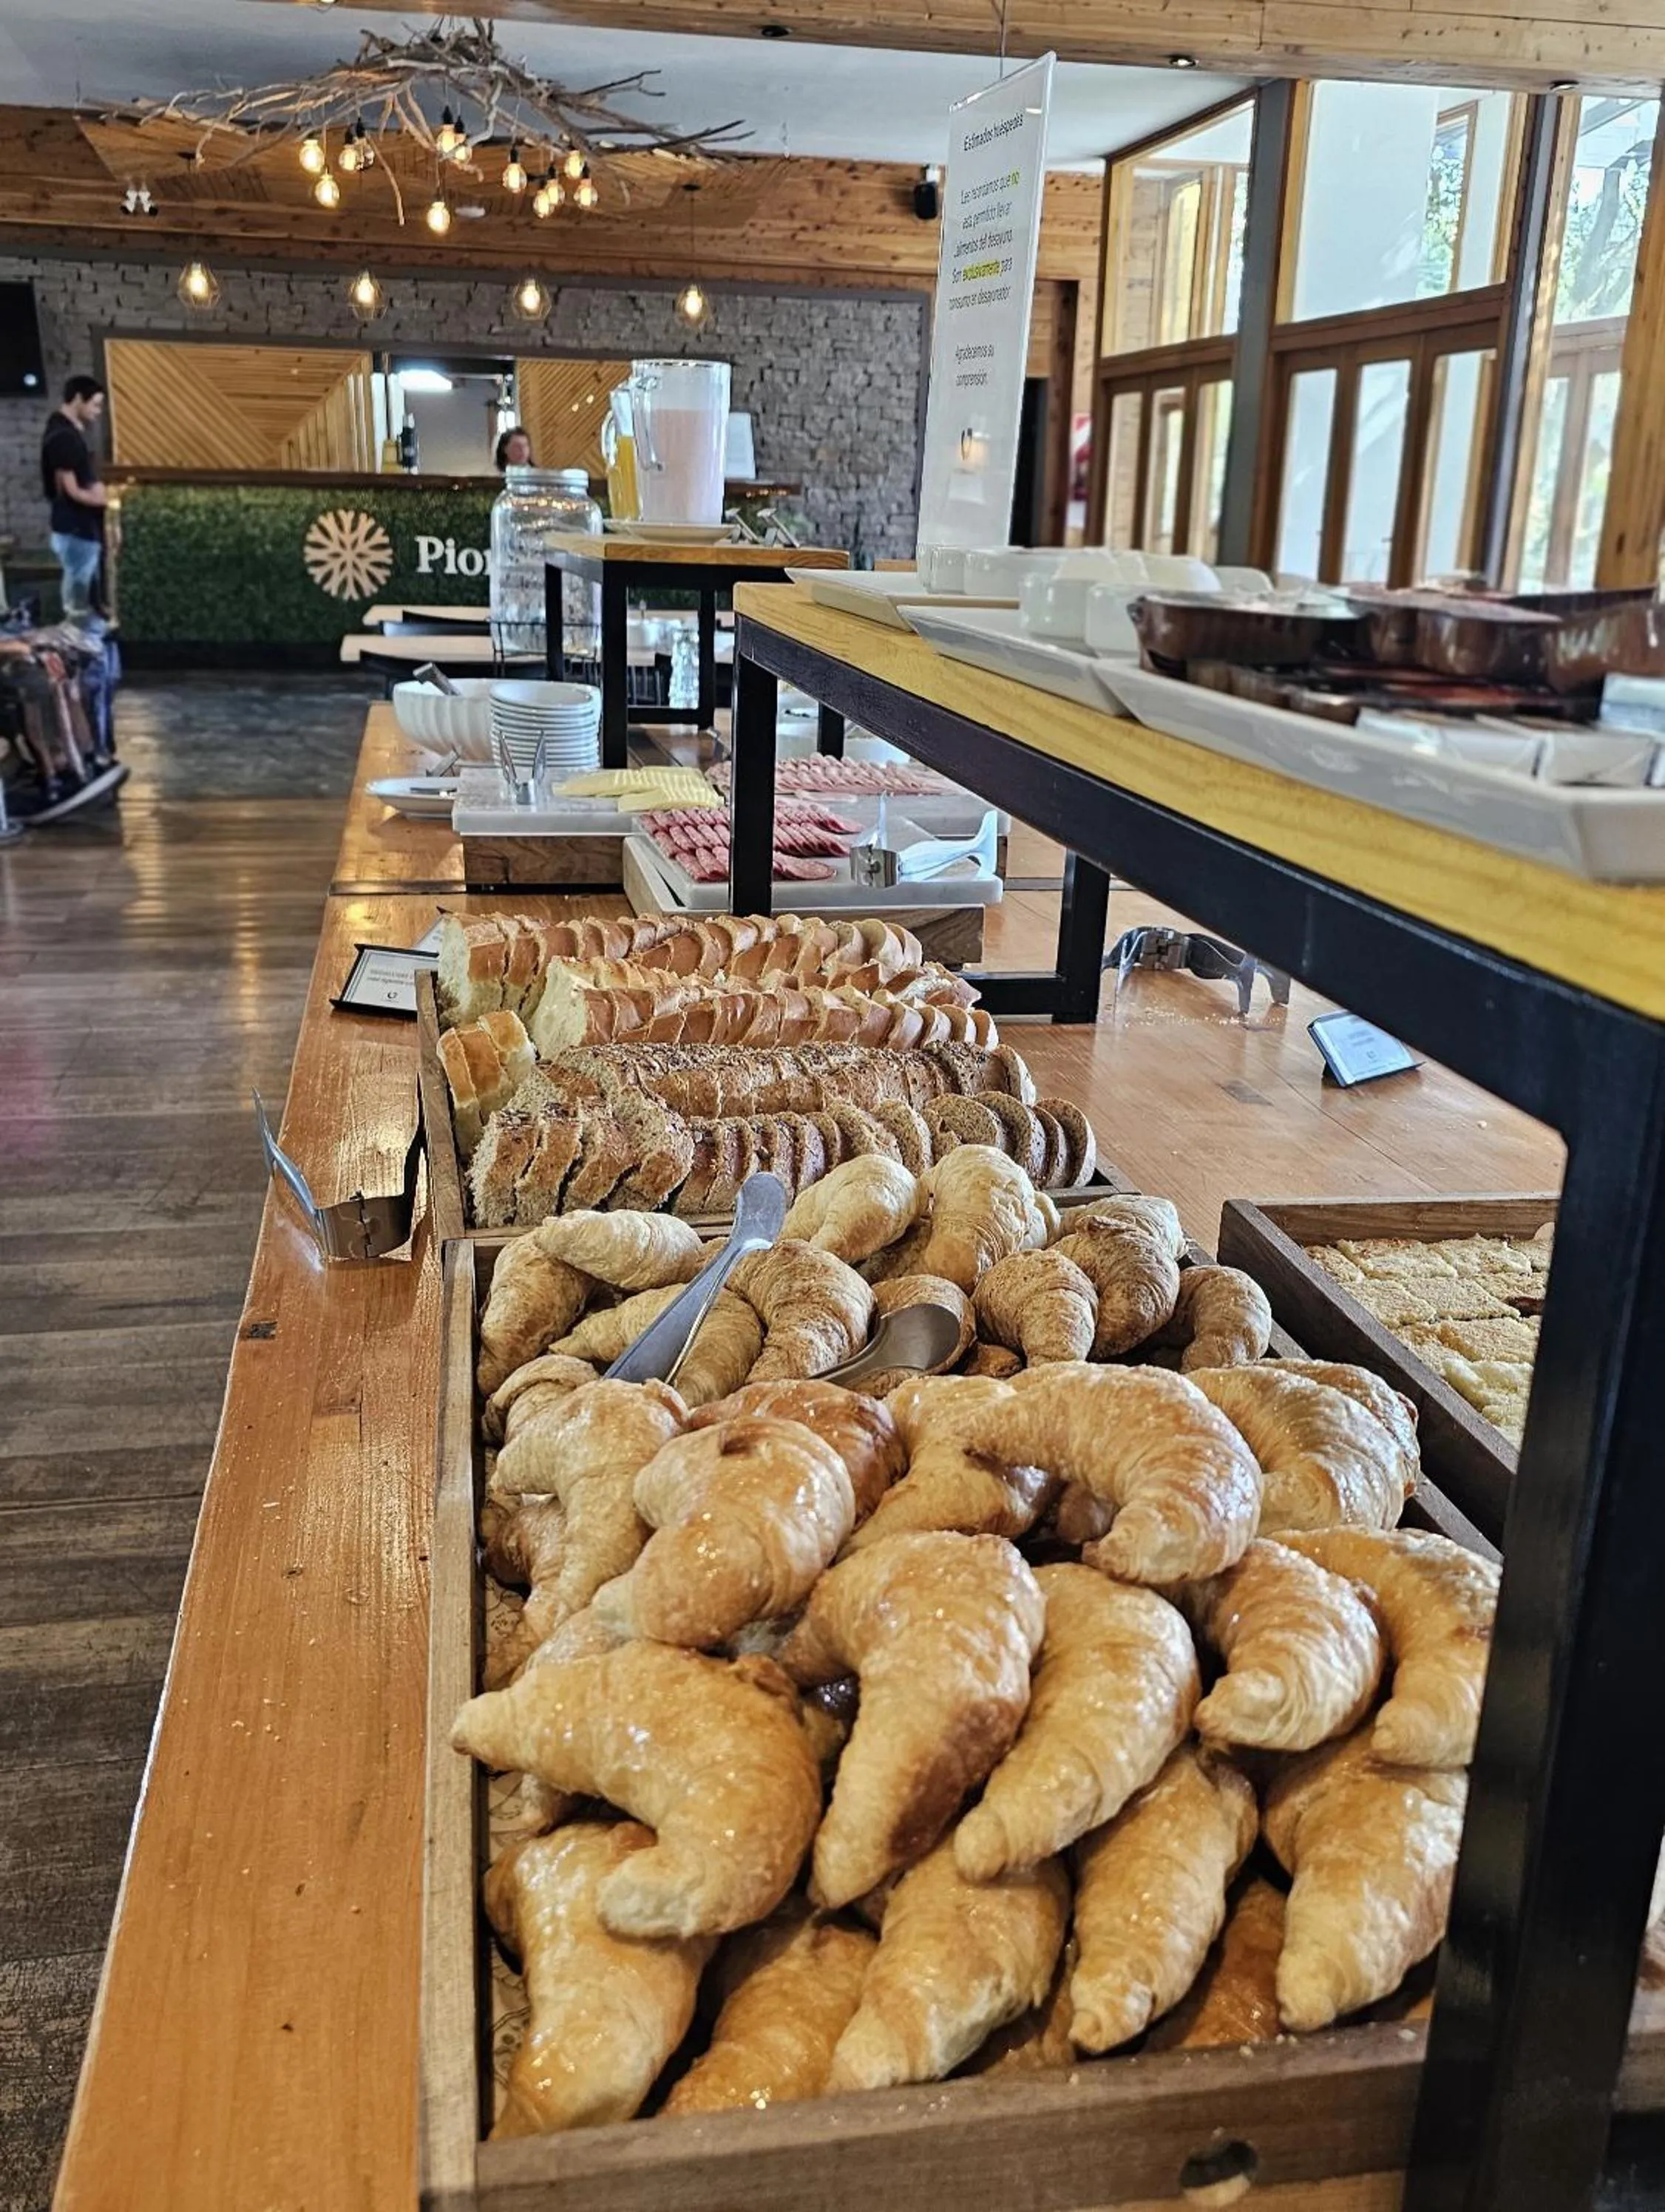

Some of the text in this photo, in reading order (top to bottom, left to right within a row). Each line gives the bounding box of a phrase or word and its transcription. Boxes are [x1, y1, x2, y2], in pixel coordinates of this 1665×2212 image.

[963, 127, 993, 152] Estimados
[1000, 174, 1010, 193] que
[1010, 171, 1020, 186] no
[1000, 256, 1012, 277] para
